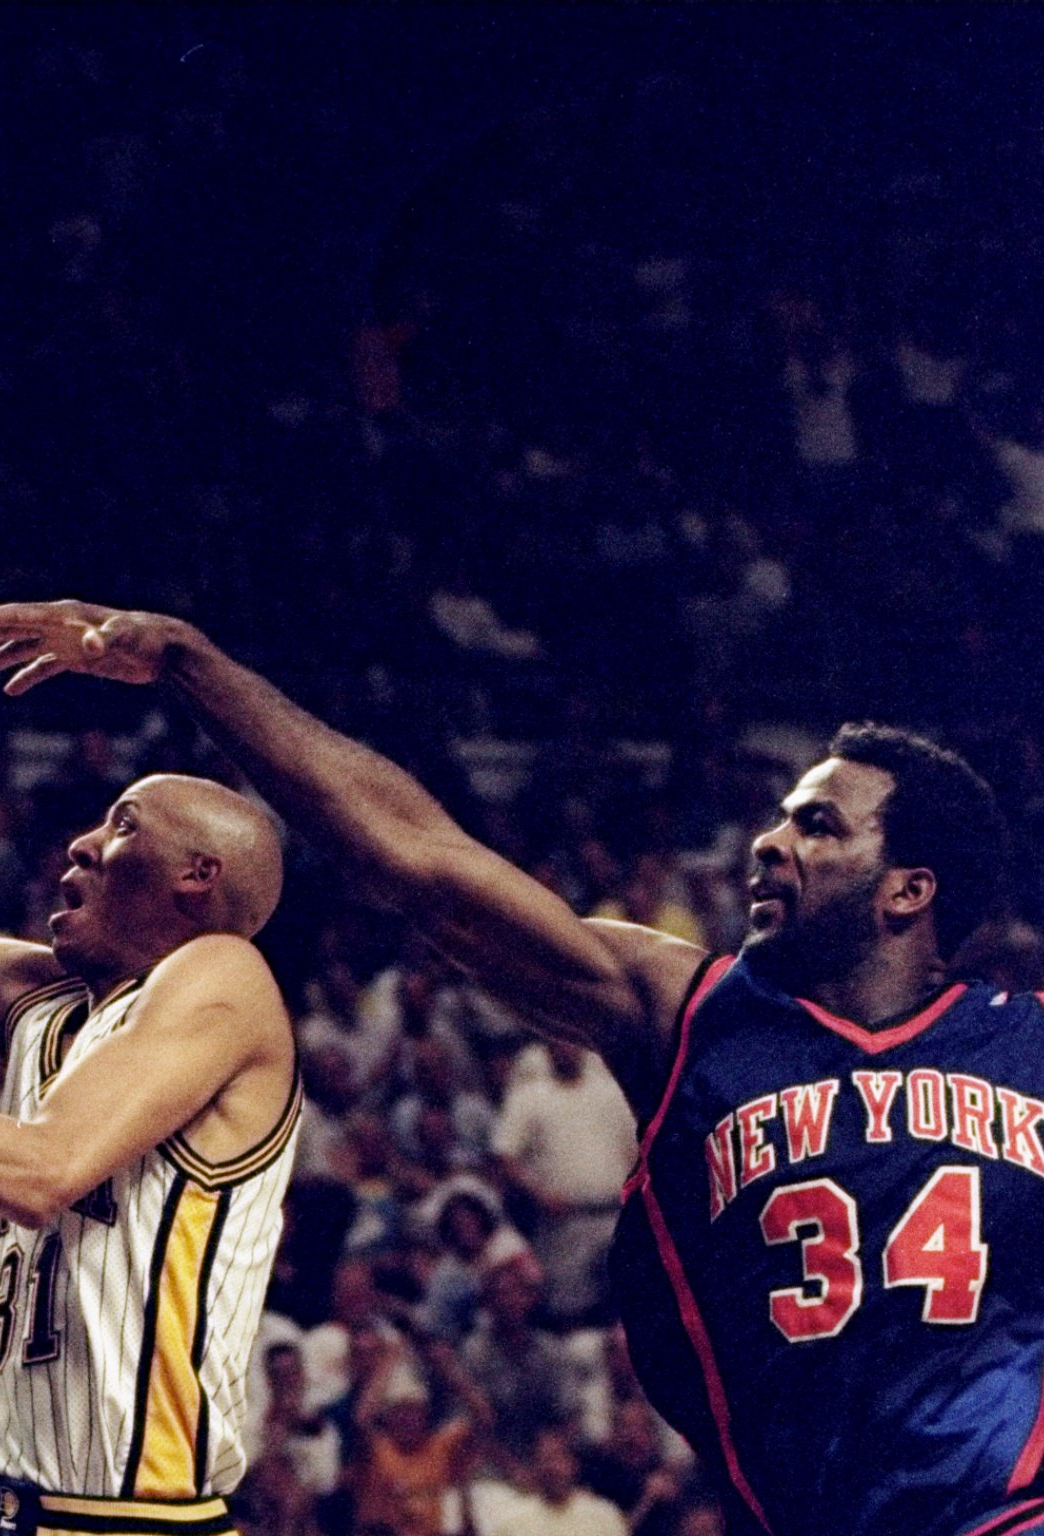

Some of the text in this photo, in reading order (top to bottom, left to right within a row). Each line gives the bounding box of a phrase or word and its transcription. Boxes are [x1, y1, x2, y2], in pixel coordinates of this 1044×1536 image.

[705, 1069, 1044, 1223] NEW YORK
[759, 1166, 989, 1343] 34
